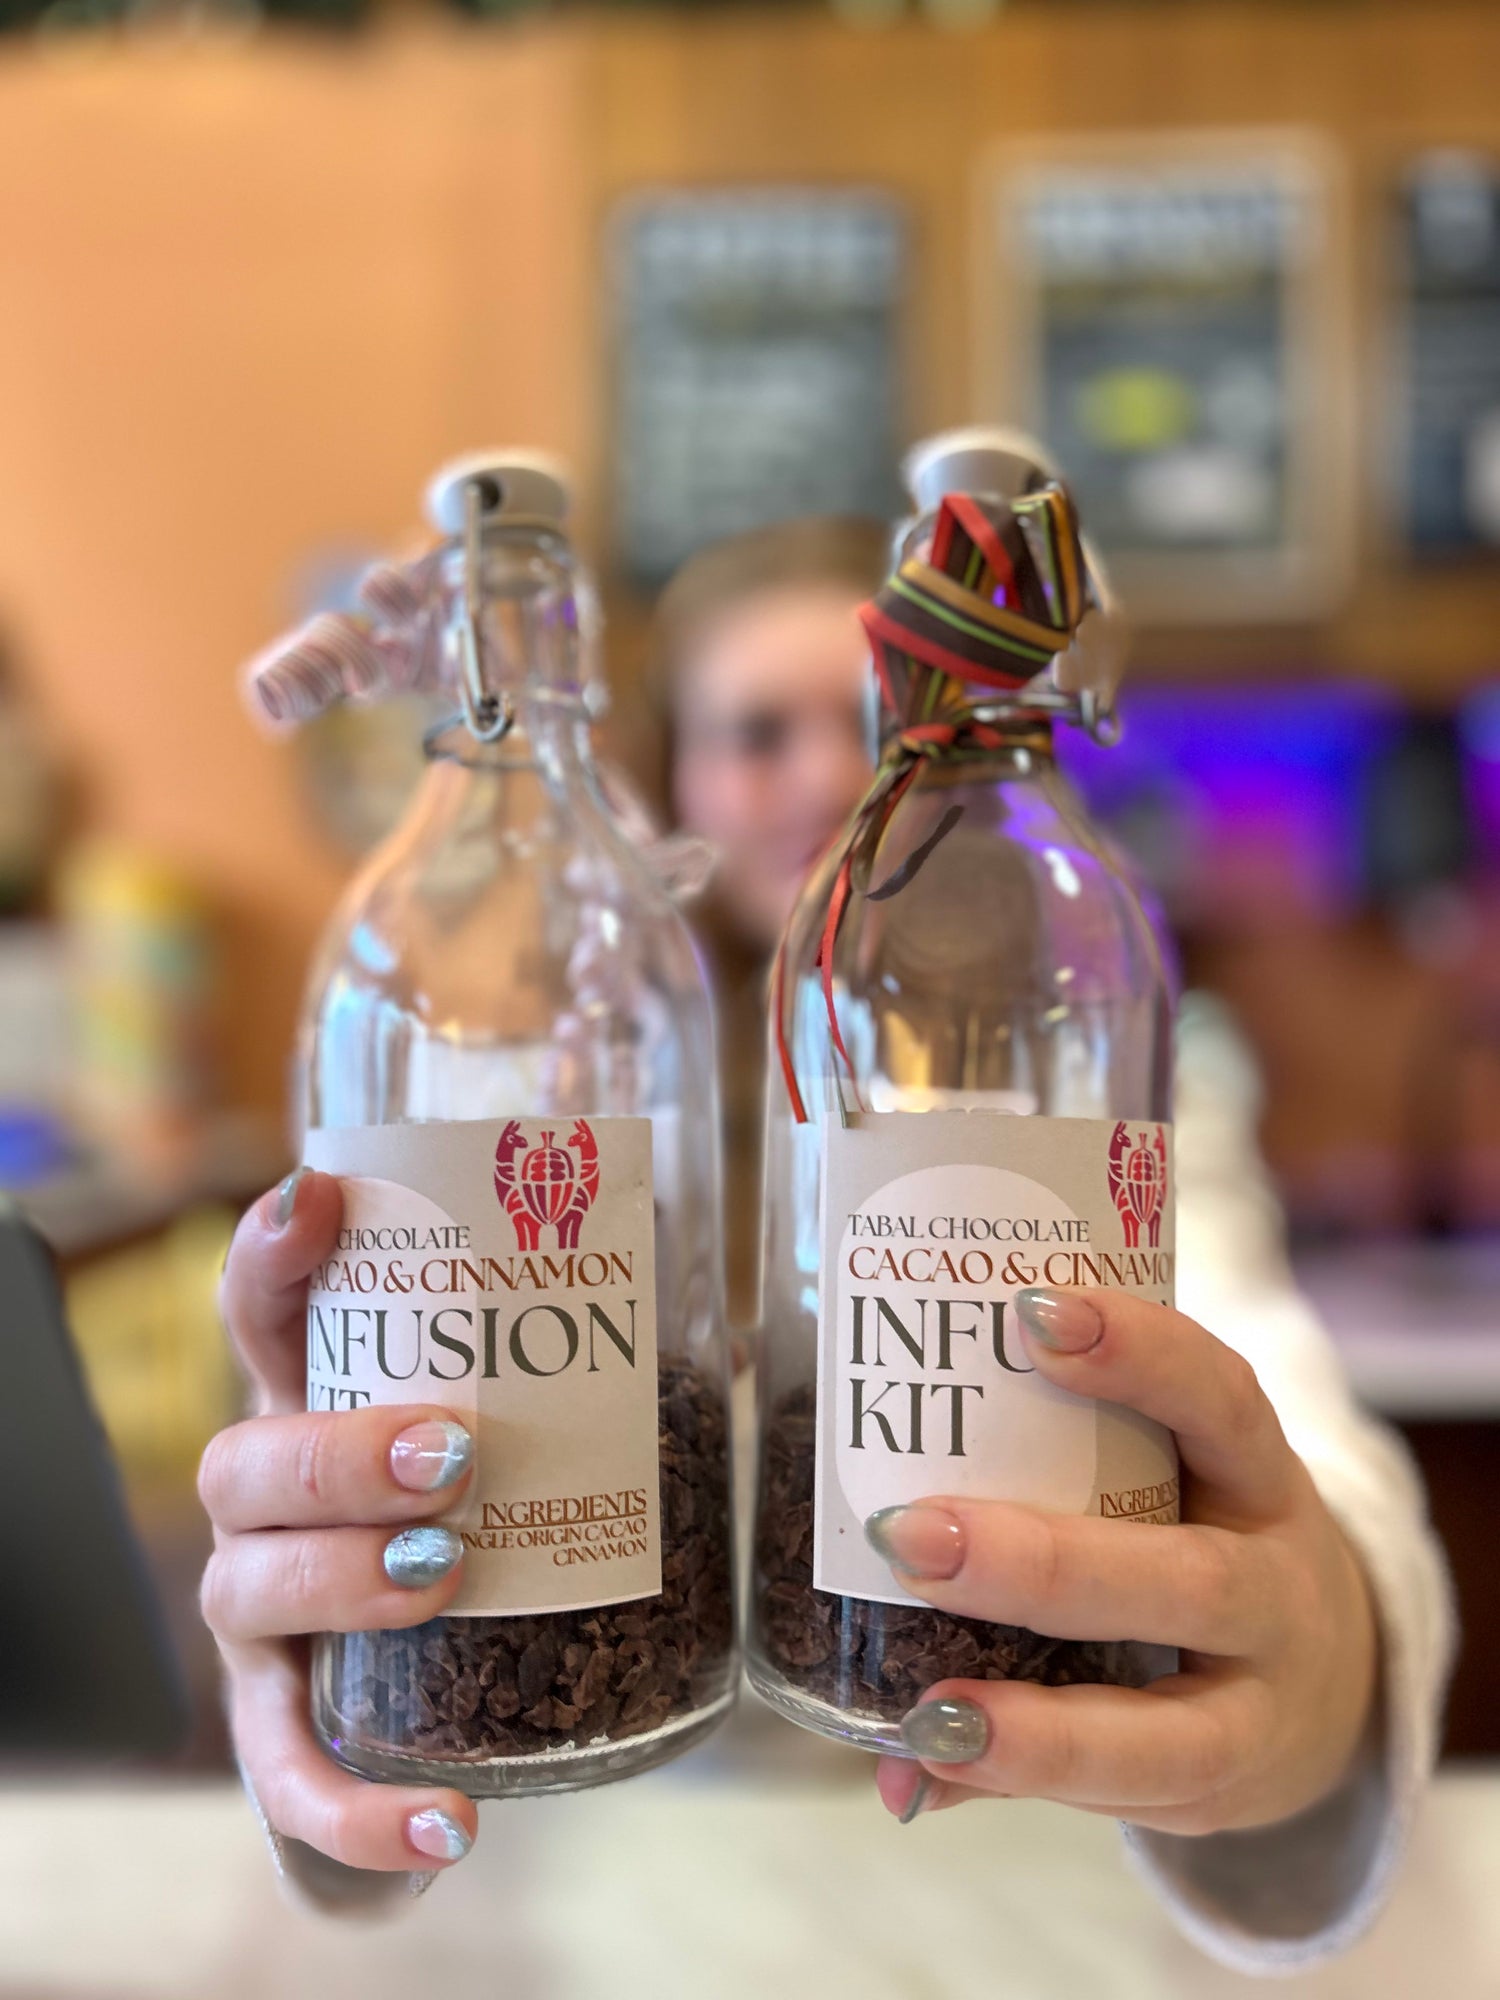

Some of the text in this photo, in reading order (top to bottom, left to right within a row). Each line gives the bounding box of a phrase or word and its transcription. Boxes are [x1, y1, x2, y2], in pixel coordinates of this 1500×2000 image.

[337, 1226, 471, 1251] CHOCOLATE
[848, 1214, 1090, 1243] TABAL CHOCOLATE
[309, 1252, 633, 1293] ACAO & CINNAMON
[849, 1246, 1174, 1287] CACAO & CINNAMO
[310, 1300, 638, 1380] INFUSION
[849, 1378, 984, 1456] KIT
[481, 1488, 647, 1529] INGREDIENTS
[460, 1518, 647, 1549] INGLE ORIGIN CACAO
[553, 1537, 647, 1567] CINNAMON
